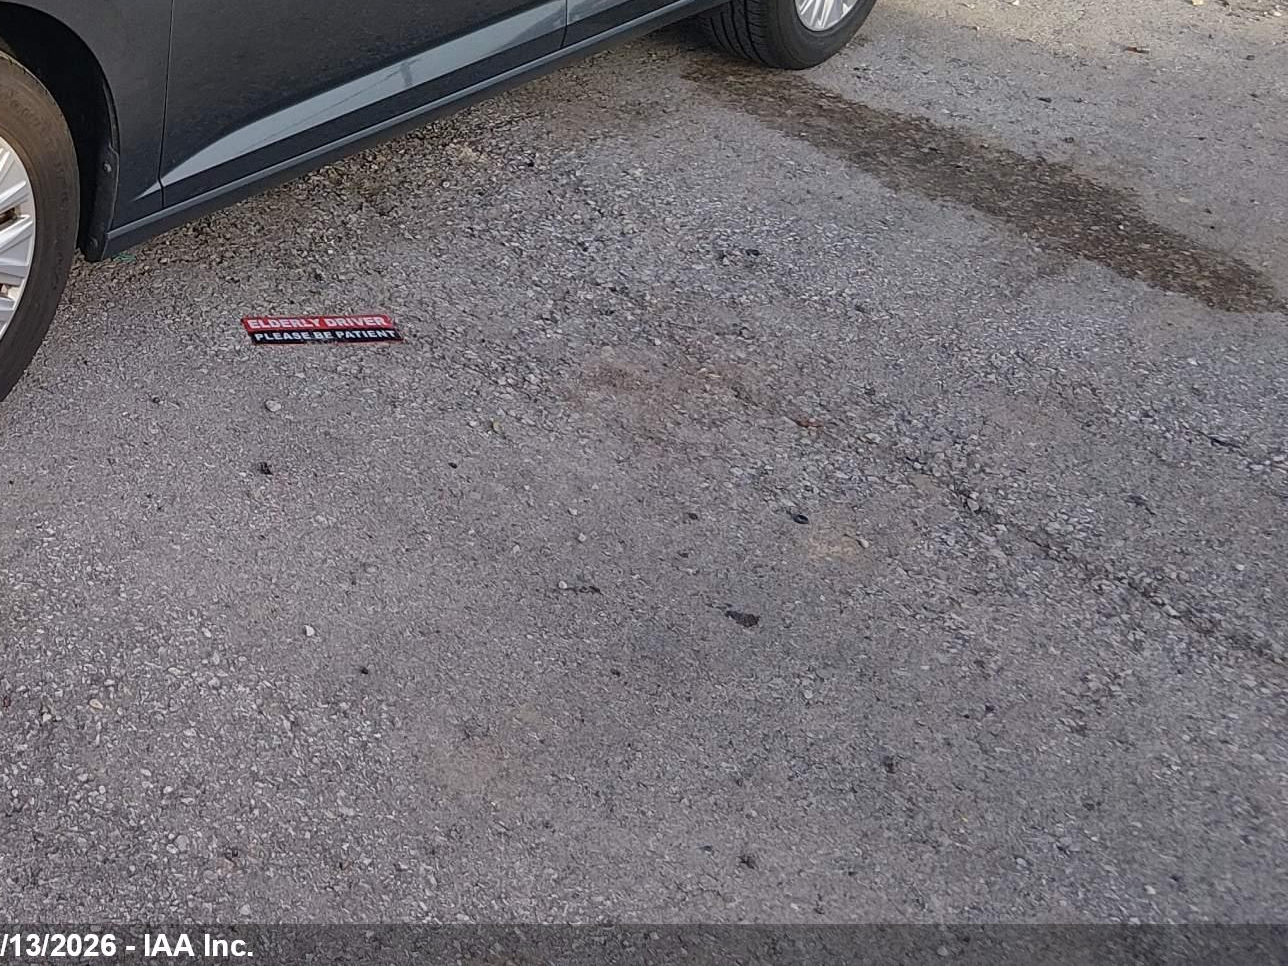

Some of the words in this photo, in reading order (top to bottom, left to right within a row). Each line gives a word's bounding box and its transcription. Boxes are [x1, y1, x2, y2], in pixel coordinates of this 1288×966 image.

[247, 318, 321, 329] ELDERLY
[323, 316, 388, 327] DRIVER
[254, 332, 312, 341] PLEASE
[312, 331, 334, 339] BE
[334, 330, 396, 339] PATIENT
